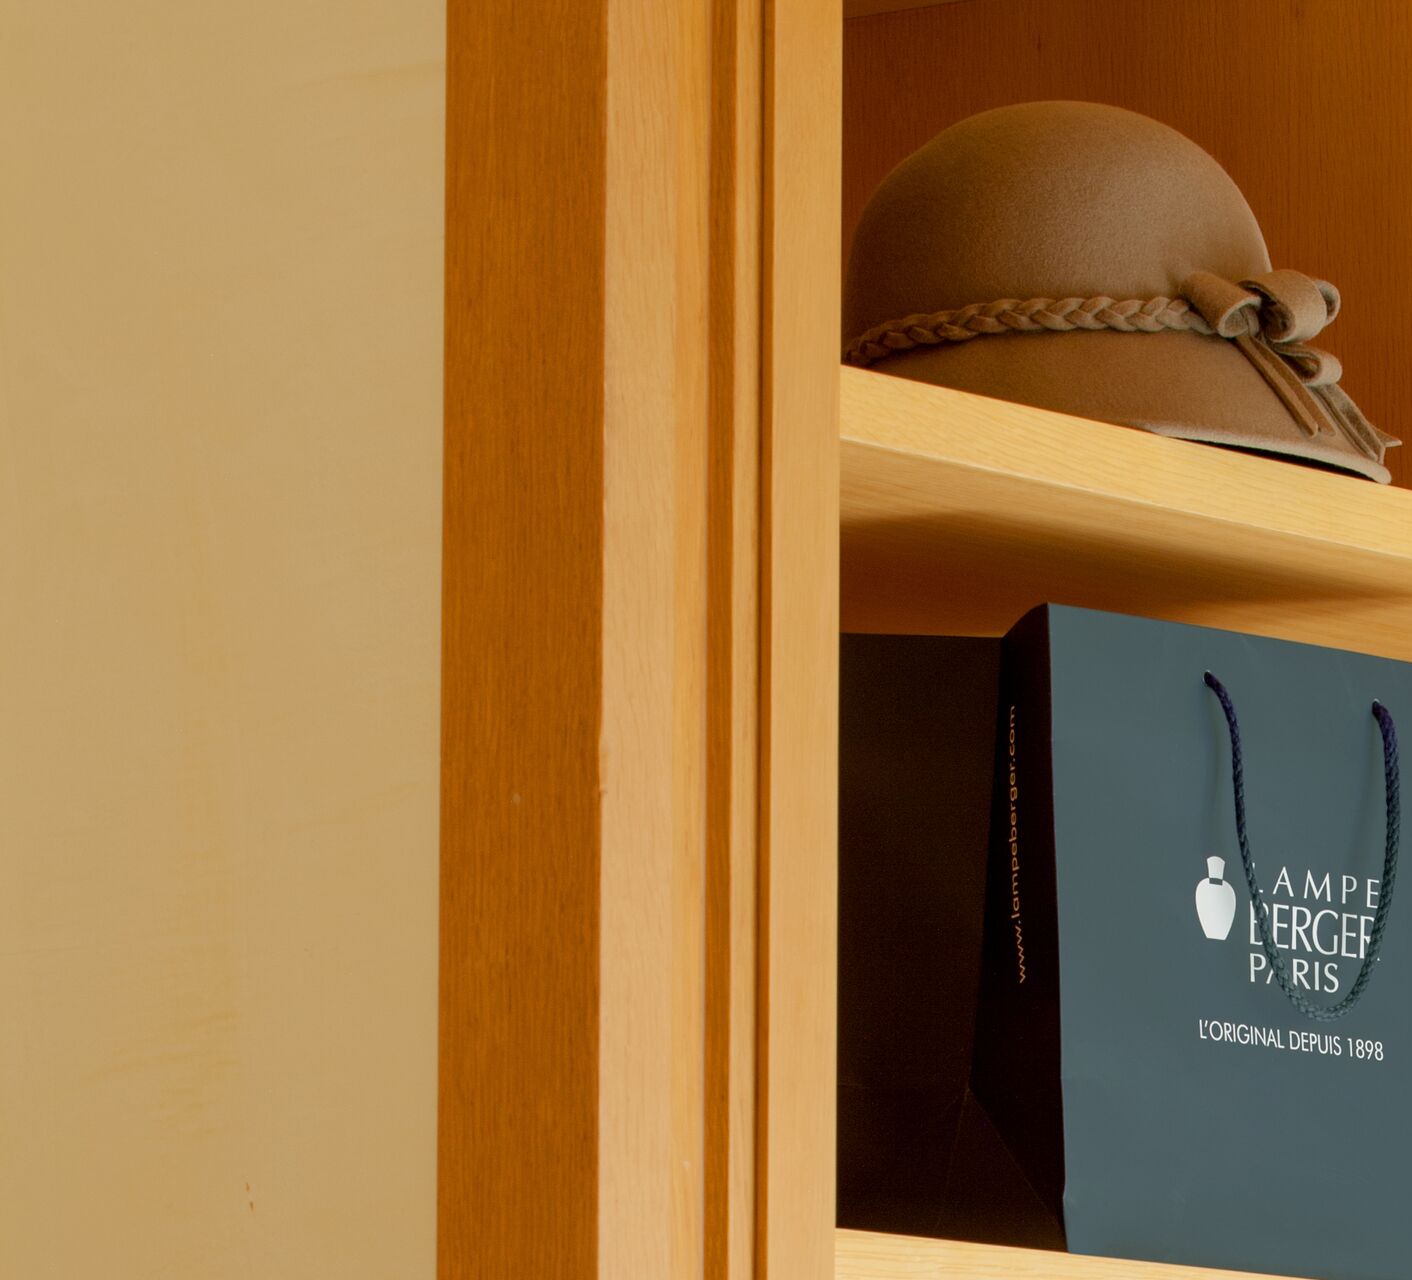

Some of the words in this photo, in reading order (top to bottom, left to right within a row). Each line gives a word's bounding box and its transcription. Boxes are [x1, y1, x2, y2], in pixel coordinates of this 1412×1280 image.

[1008, 705, 1026, 984] www.lampeberger.com
[1251, 863, 1380, 909] AMPE
[1199, 1019, 1285, 1049] L'ORIGINAL
[1289, 1030, 1342, 1056] DEPUIS
[1347, 1038, 1384, 1061] 1898
